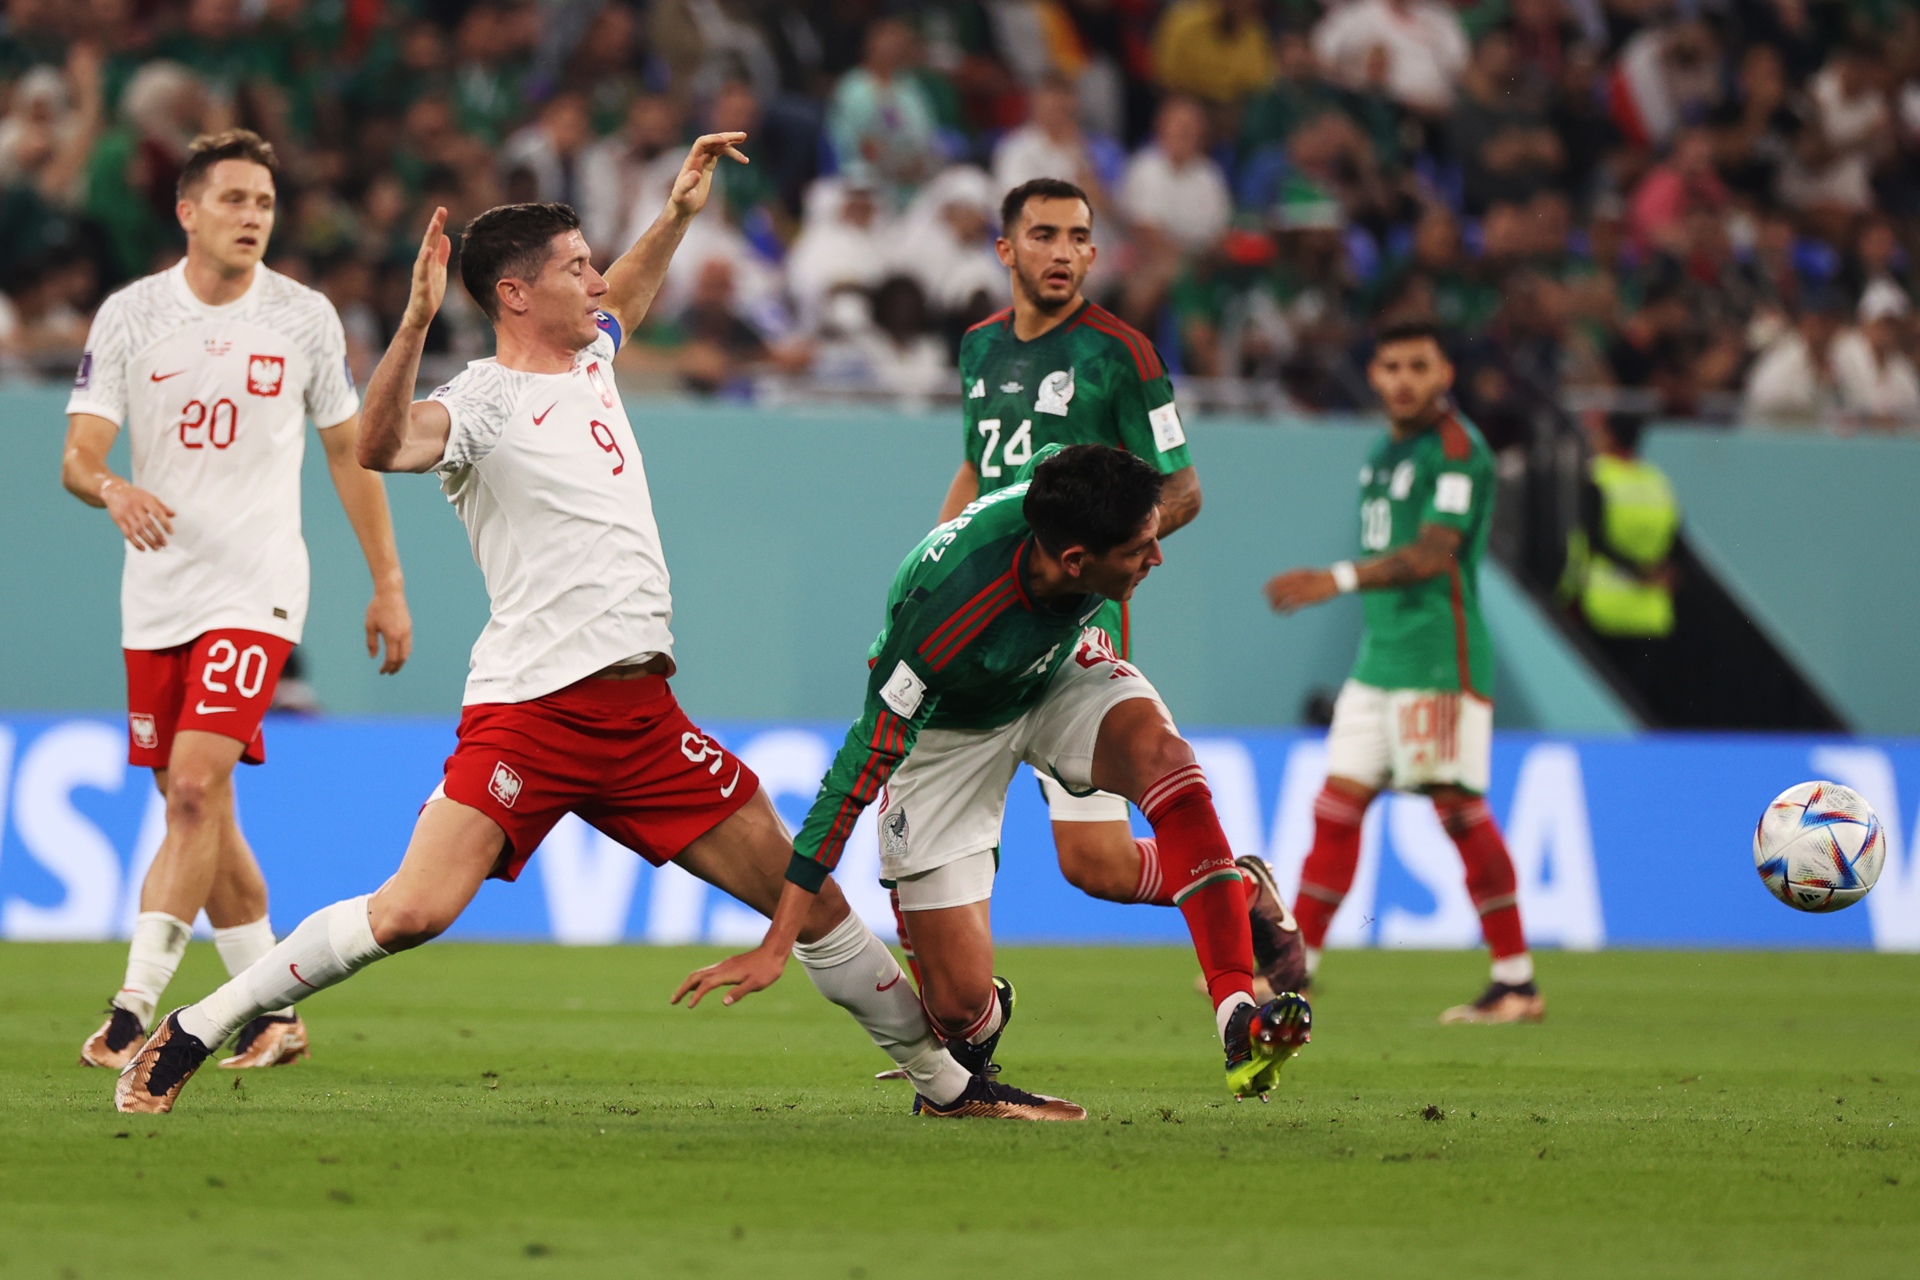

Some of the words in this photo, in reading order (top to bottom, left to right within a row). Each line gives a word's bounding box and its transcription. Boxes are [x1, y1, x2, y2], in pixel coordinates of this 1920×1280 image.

[179, 398, 238, 450] 20
[589, 419, 625, 477] 9
[978, 418, 1033, 478] 24
[202, 638, 269, 699] 20
[681, 731, 723, 776] 9
